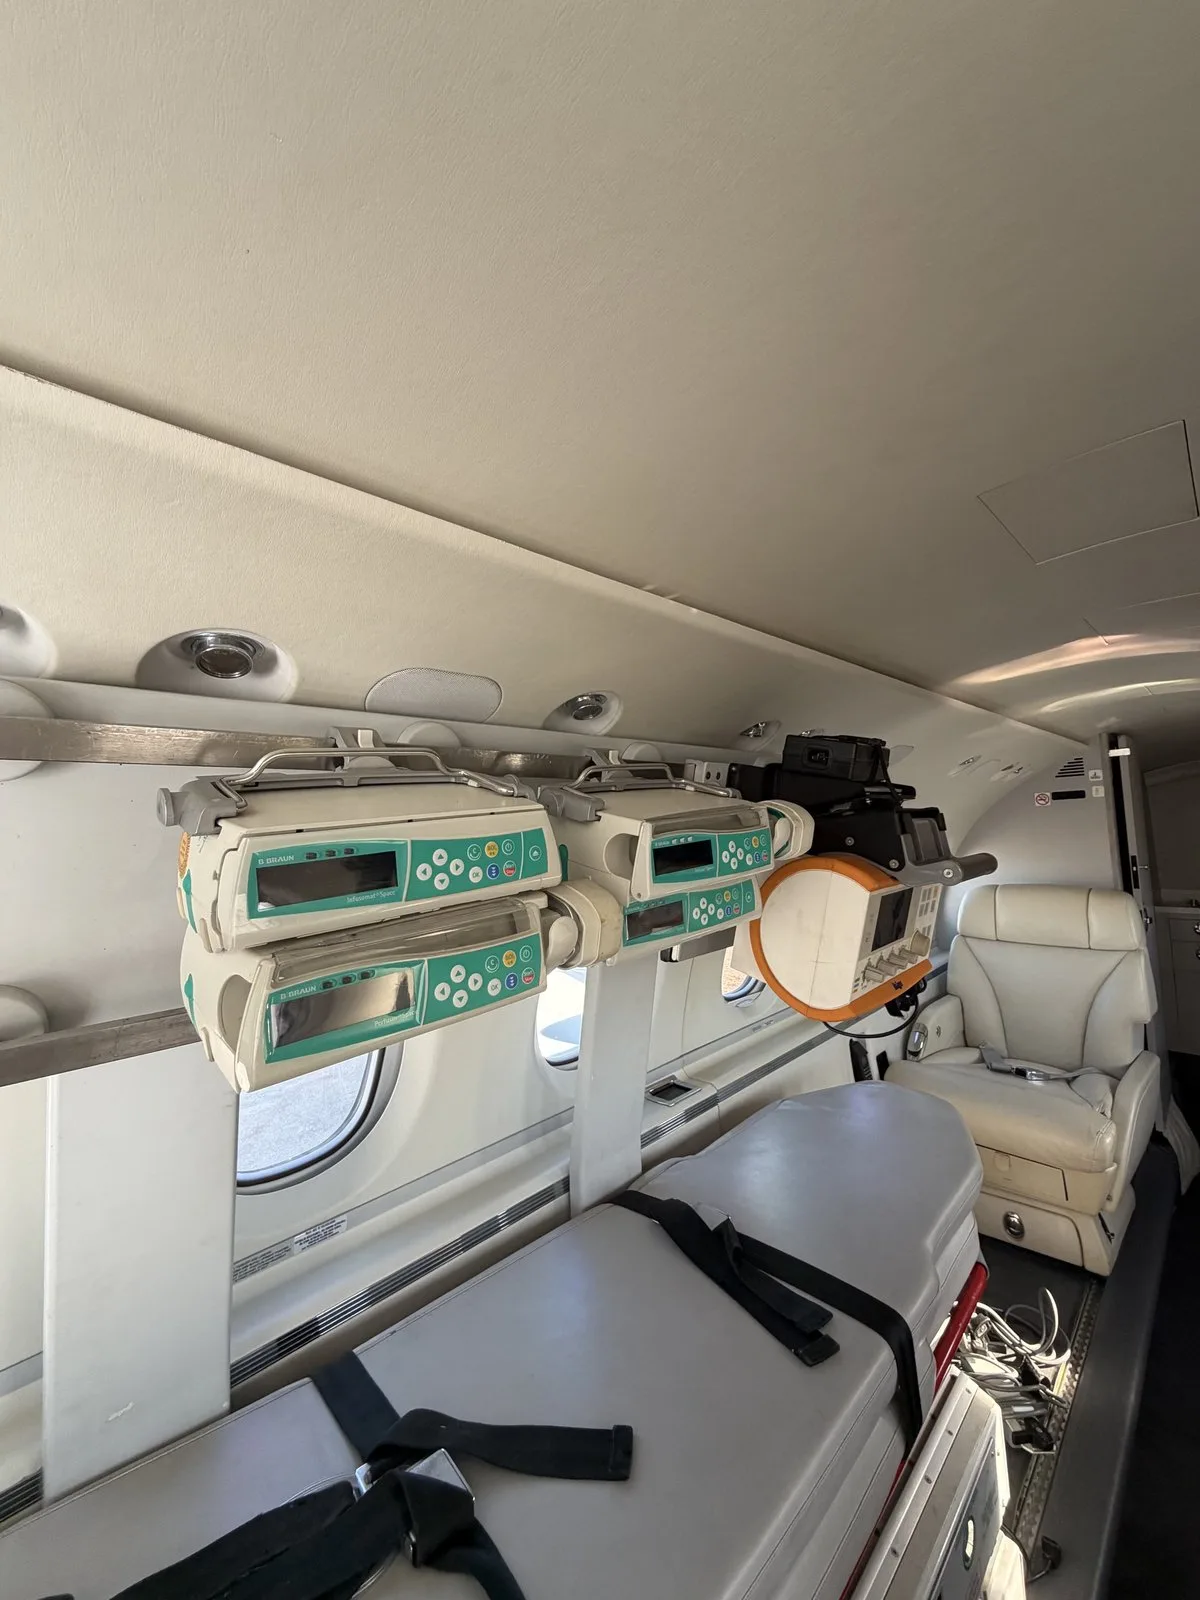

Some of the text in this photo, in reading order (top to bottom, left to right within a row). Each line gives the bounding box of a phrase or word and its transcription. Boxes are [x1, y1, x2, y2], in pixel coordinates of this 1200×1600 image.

[266, 855, 295, 864] BRAUN
[288, 985, 317, 998] BRAUN
[490, 983, 499, 991] OK
